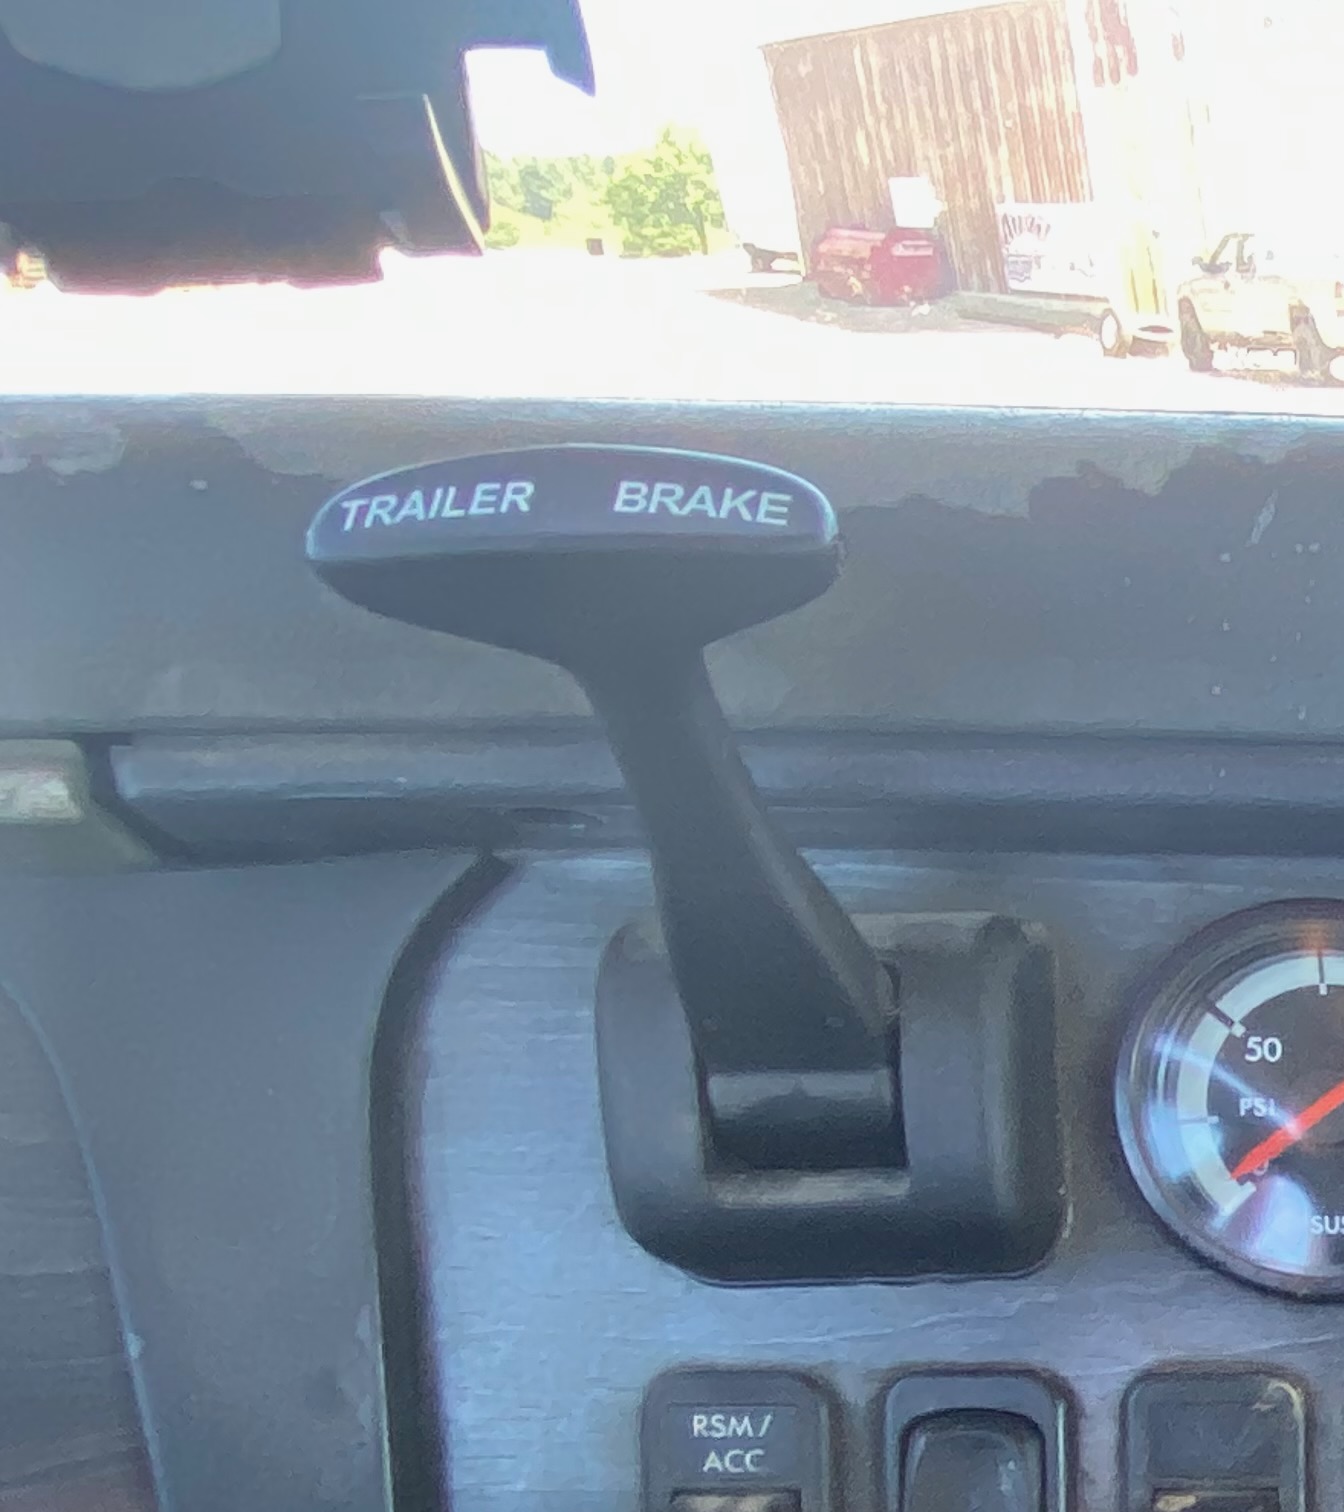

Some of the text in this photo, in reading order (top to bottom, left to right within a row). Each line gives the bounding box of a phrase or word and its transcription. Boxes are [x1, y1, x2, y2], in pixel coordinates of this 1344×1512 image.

[340, 480, 793, 532] TRAILER BRAKE
[1244, 1037, 1282, 1062] 50
[1239, 1098, 1276, 1117] PSI
[702, 1449, 766, 1474] ACC
